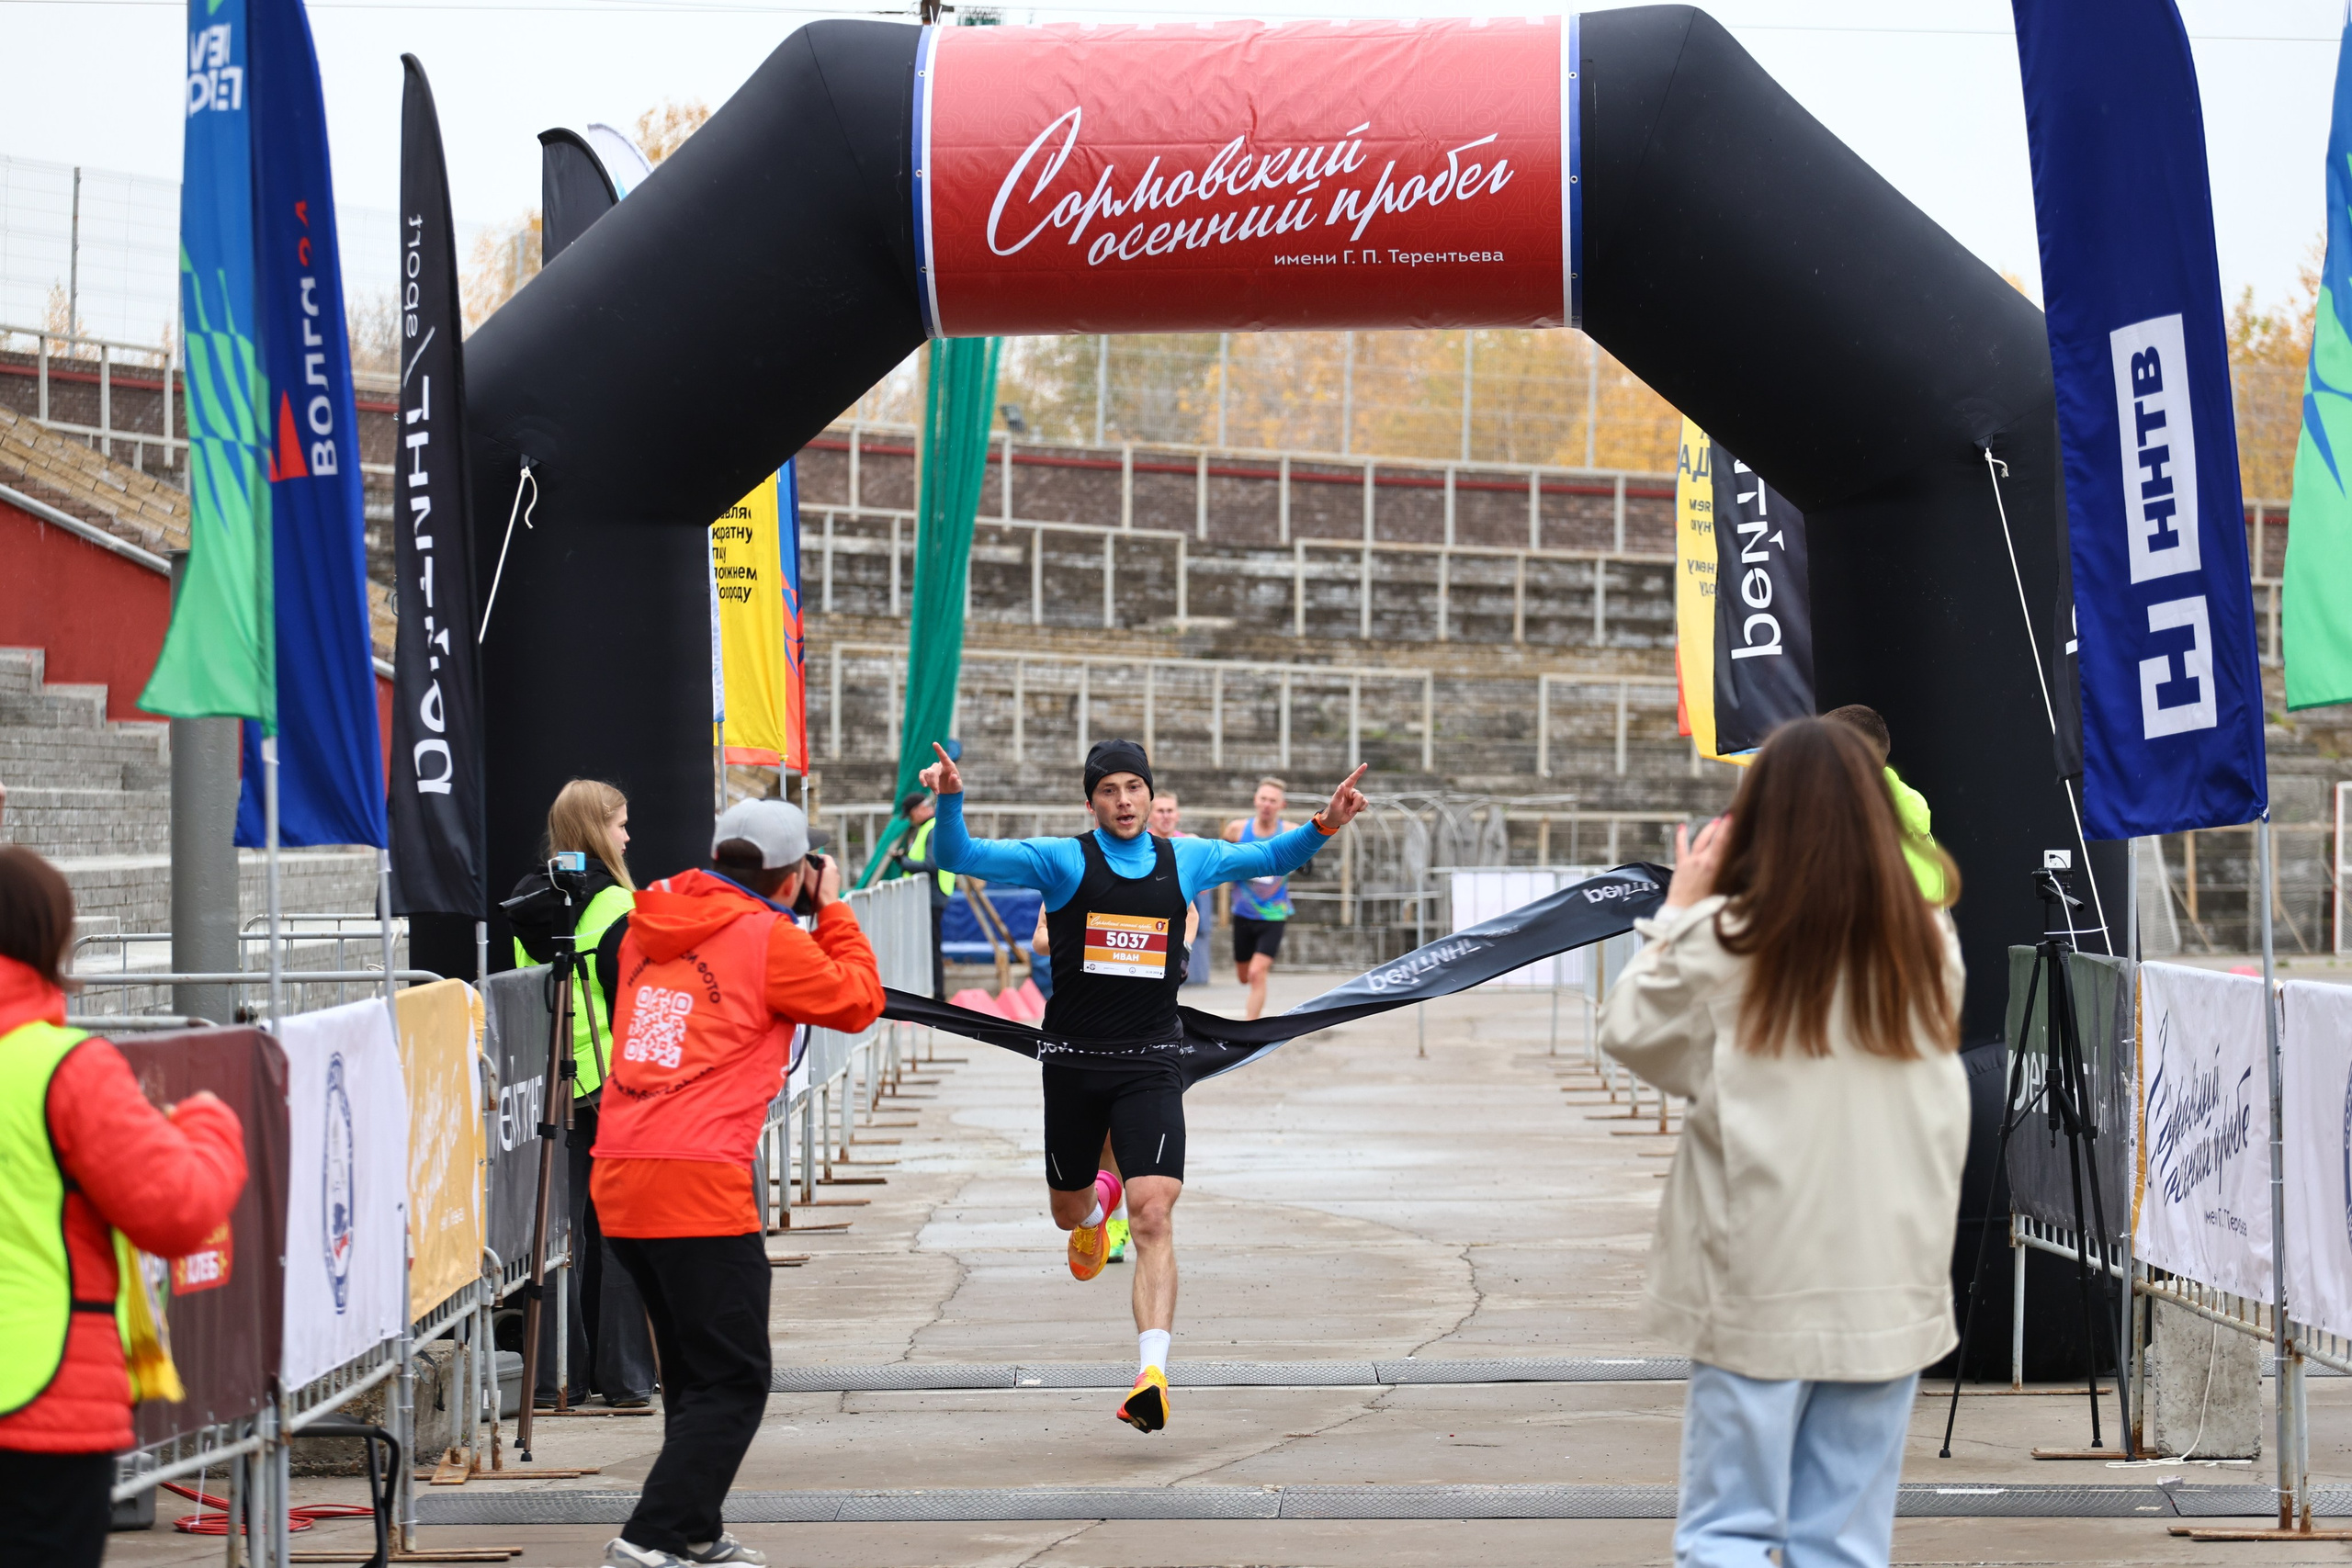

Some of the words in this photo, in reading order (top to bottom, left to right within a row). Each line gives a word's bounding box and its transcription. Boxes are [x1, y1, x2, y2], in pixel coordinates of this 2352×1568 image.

[987, 106, 1370, 256] Сормовский
[1087, 181, 1320, 266] осенний
[1325, 132, 1514, 243] пробег
[1274, 253, 1337, 265] имени
[1343, 250, 1355, 265] Г.
[1363, 249, 1382, 265] П.
[1388, 249, 1504, 267] Терентьева
[2131, 345, 2179, 553] ННТВ
[1106, 931, 1149, 949] 5037
[1113, 952, 1139, 962] ИВАН
[697, 962, 721, 1004] ФОТО
